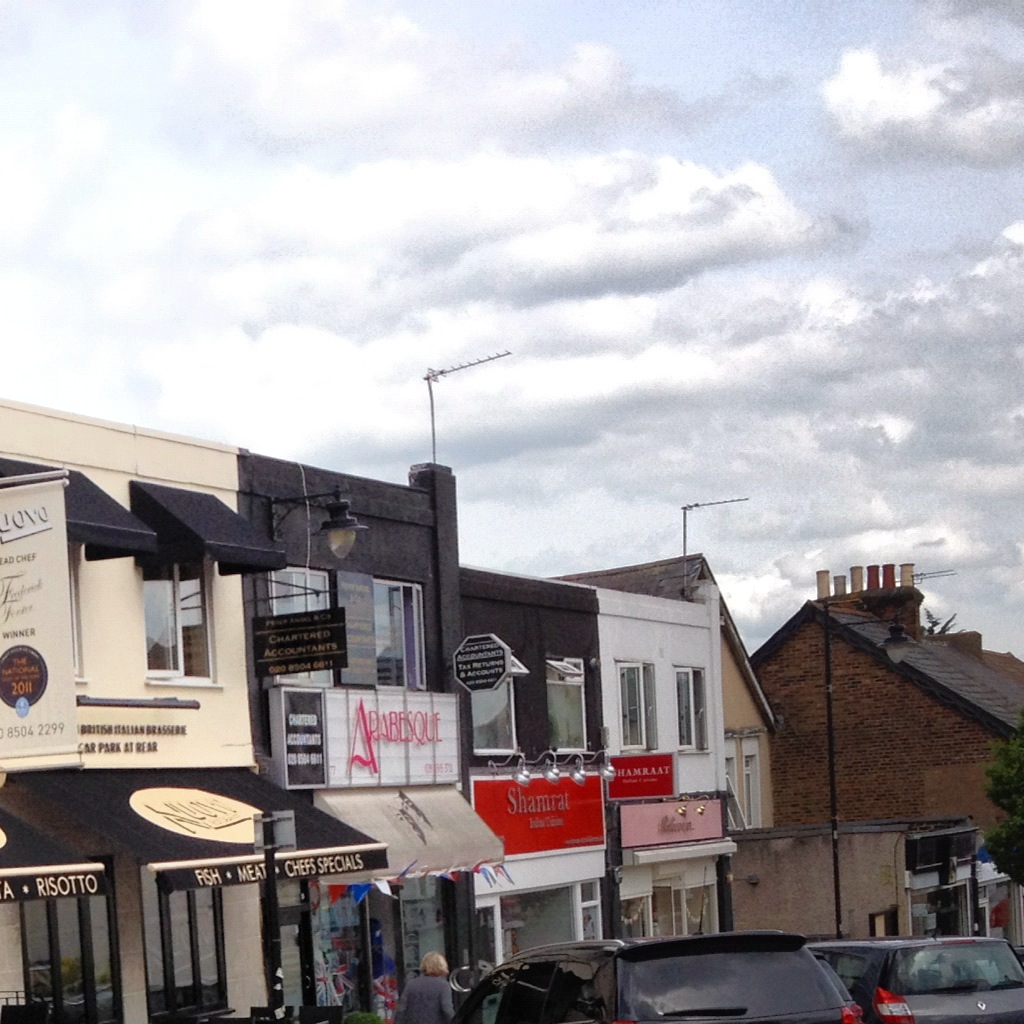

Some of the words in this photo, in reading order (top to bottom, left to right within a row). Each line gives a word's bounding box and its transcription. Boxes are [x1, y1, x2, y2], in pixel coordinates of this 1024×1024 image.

[16, 553, 37, 563] CHEF
[2, 628, 36, 639] WINNER
[11, 681, 32, 695] 2011
[6, 726, 34, 737] 8504
[38, 723, 65, 735] 2299
[347, 697, 443, 776] ARABESQUE
[98, 742, 122, 753] PARK
[124, 742, 134, 752] AT
[136, 742, 158, 752] REAR
[194, 868, 223, 887] FISH
[237, 863, 268, 883] MEAT
[284, 858, 316, 878] CHEFS
[317, 855, 364, 875] SPECIALS
[36, 874, 99, 898] RISOTTO
